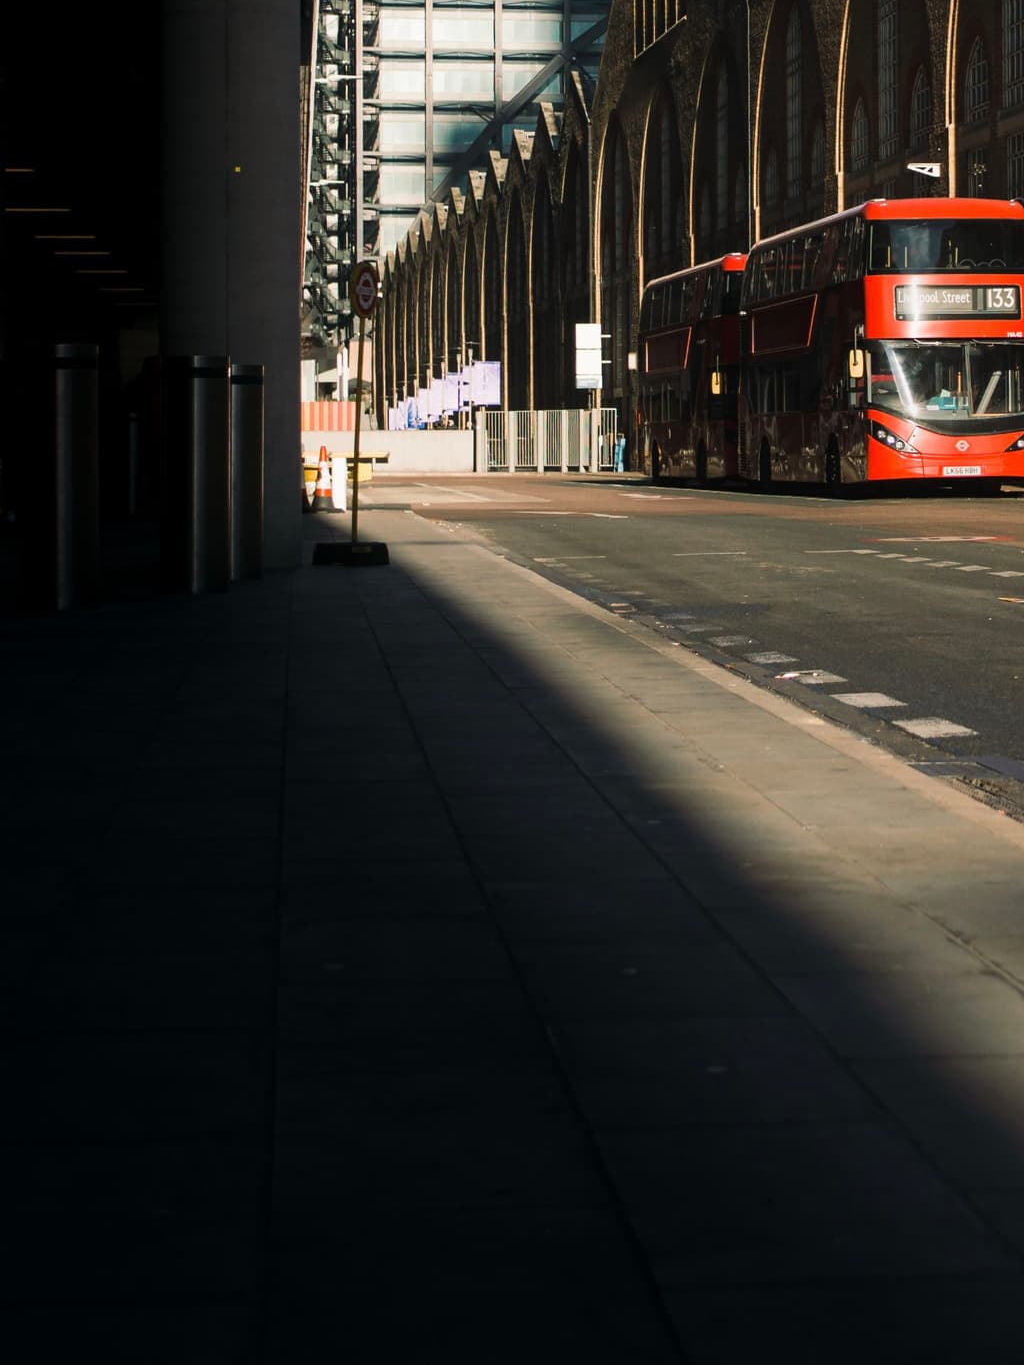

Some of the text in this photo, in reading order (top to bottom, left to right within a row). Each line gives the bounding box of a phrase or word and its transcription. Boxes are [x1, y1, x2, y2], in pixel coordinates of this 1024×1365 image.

[898, 288, 971, 305] Livpool Street
[988, 288, 1015, 308] 133
